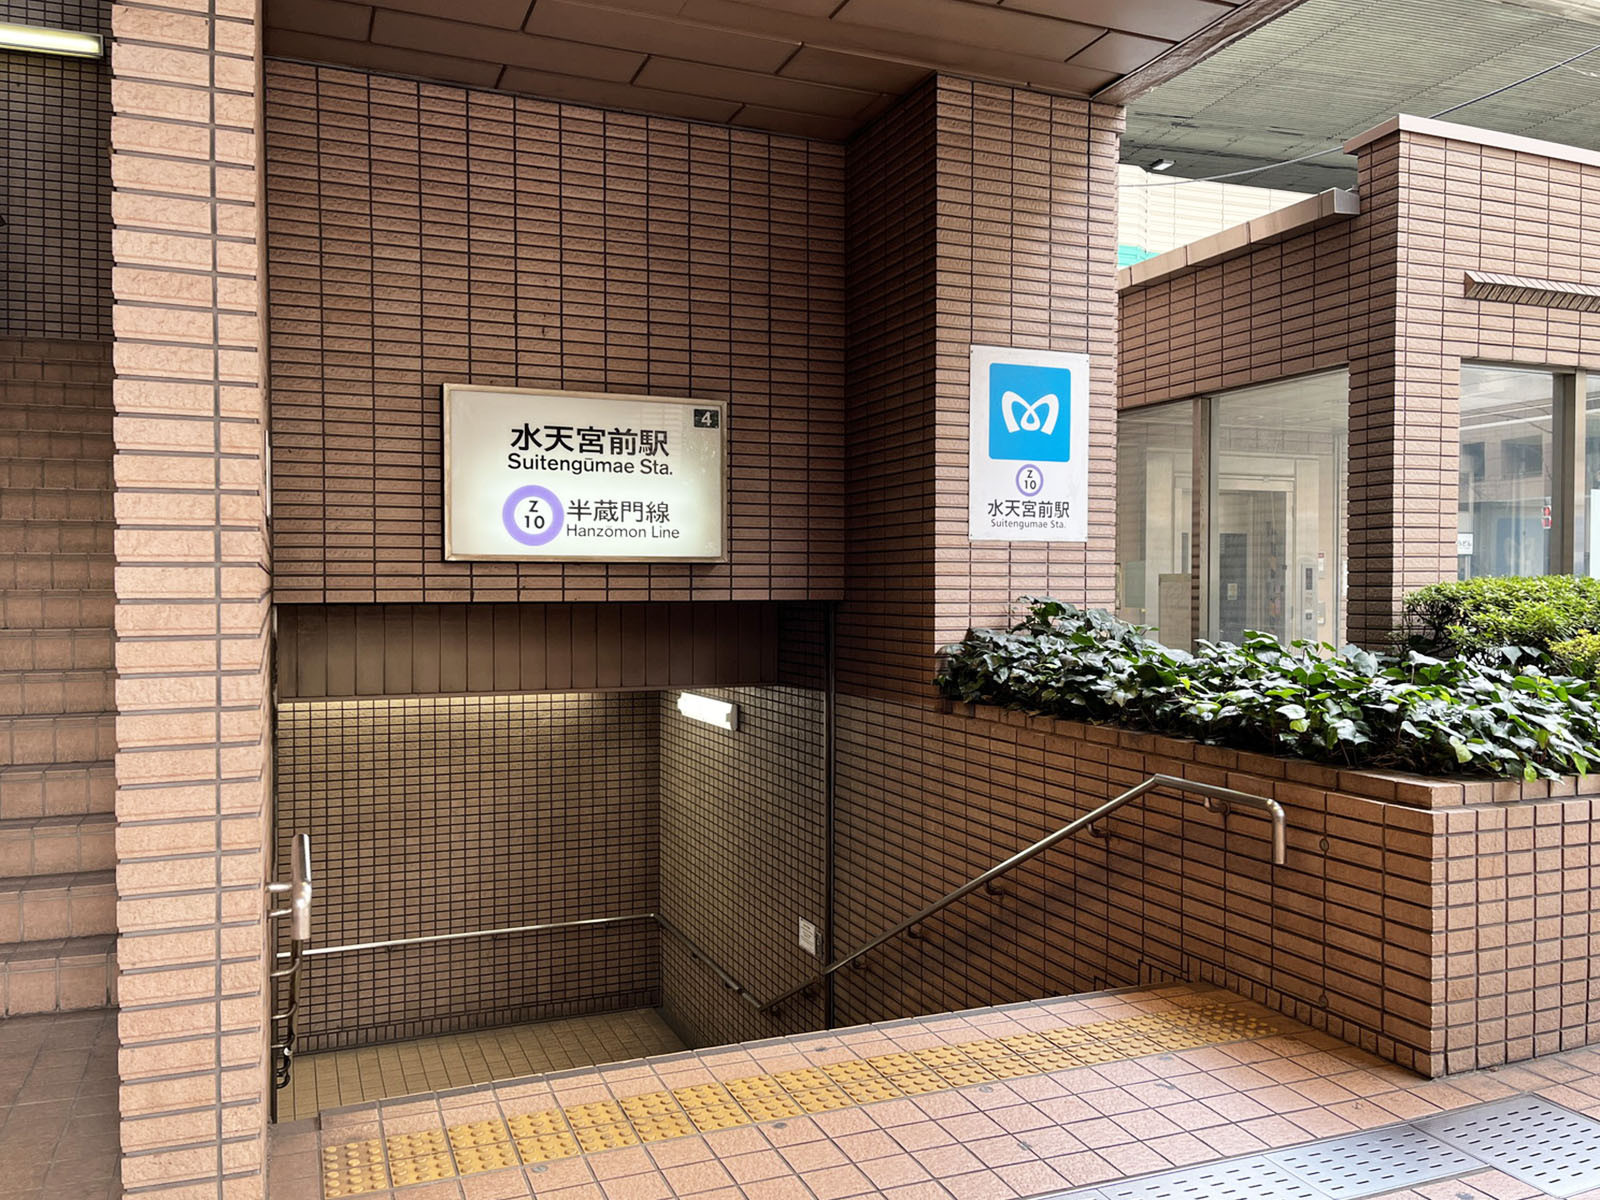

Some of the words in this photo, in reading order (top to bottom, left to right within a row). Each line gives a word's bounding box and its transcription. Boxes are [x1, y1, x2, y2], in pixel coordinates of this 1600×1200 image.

[701, 411, 713, 427] 4
[510, 423, 670, 457] 水天宮前駅
[508, 452, 635, 475] Suitengūmae
[640, 458, 673, 475] Sta.
[1026, 469, 1034, 479] Z
[1024, 479, 1037, 490] 10
[528, 500, 539, 513] Z
[566, 498, 671, 524] 半蔵門線
[987, 499, 1070, 519] 水天宮前駅
[524, 515, 545, 529] 10
[1050, 519, 1067, 529] Sta.
[566, 523, 647, 538] Hanzōmon
[651, 525, 681, 539] Line
